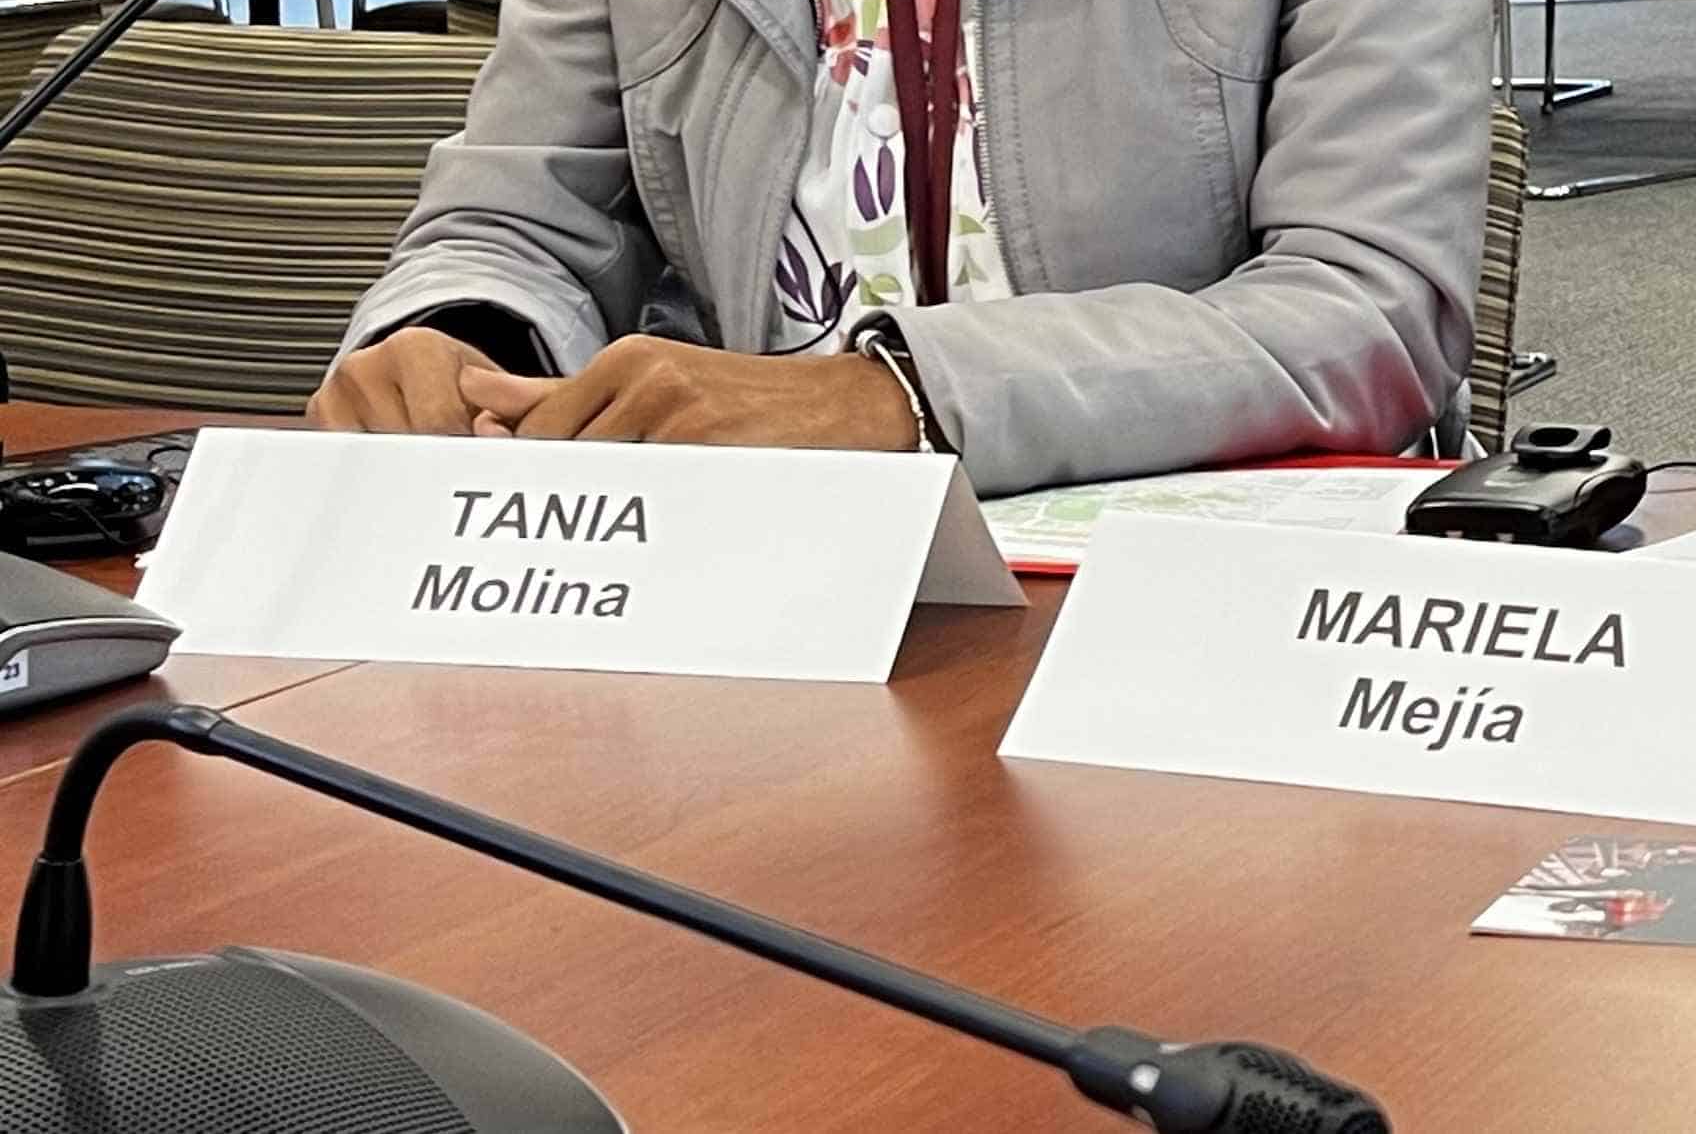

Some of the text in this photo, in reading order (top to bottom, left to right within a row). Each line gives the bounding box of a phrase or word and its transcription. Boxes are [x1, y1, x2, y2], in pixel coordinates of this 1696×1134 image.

[453, 490, 648, 543] TANIA
[411, 564, 631, 618] Molina
[1296, 588, 1626, 668] MARIELA
[1338, 677, 1524, 751] Mejía
